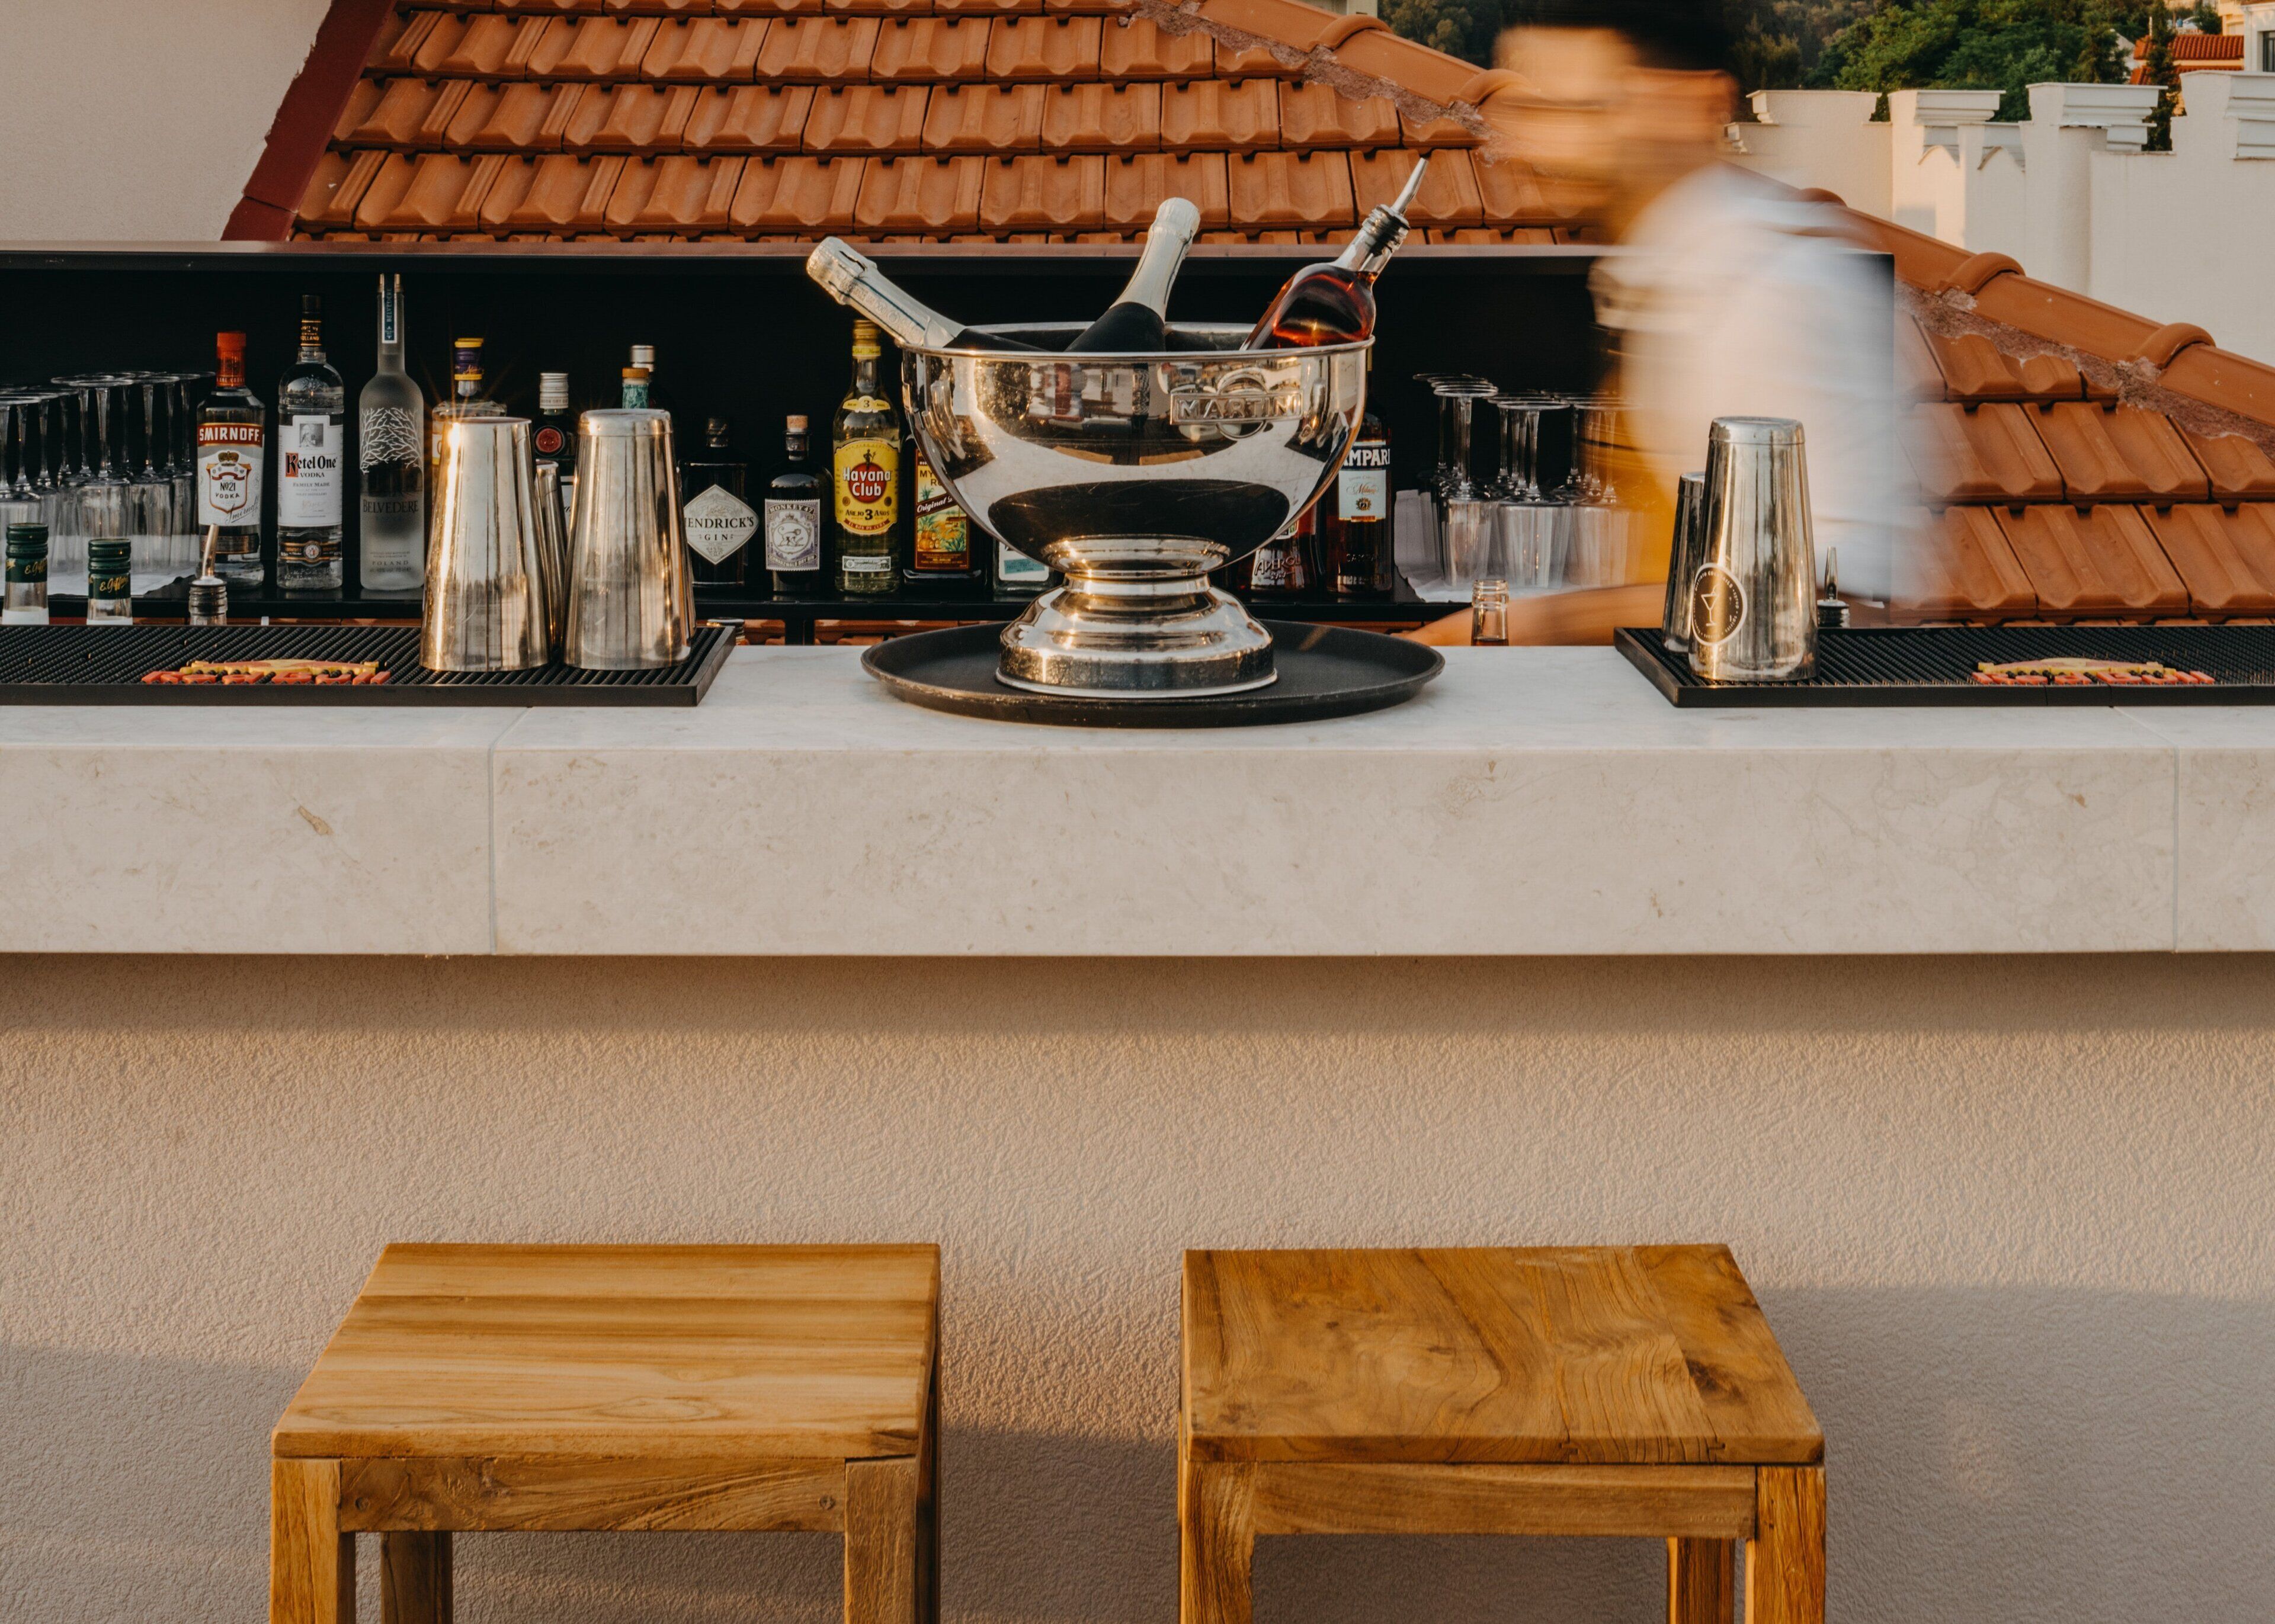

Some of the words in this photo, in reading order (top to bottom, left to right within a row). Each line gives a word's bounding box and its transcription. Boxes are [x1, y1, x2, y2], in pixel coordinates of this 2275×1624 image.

[863, 400, 870, 408] 3
[199, 427, 259, 441] SMIRNOFF
[286, 454, 316, 474] Ketel
[317, 455, 337, 469] One
[843, 466, 892, 482] Havana
[851, 482, 882, 496] Club
[363, 498, 418, 513] BELVEDERE
[770, 503, 803, 513] MONKEY
[917, 497, 947, 513] Original
[864, 509, 873, 521] 3
[684, 516, 754, 529] ENDRICK'S
[141, 670, 264, 685] Red
[271, 670, 391, 685] Bull
[2096, 670, 2215, 685] Bull
